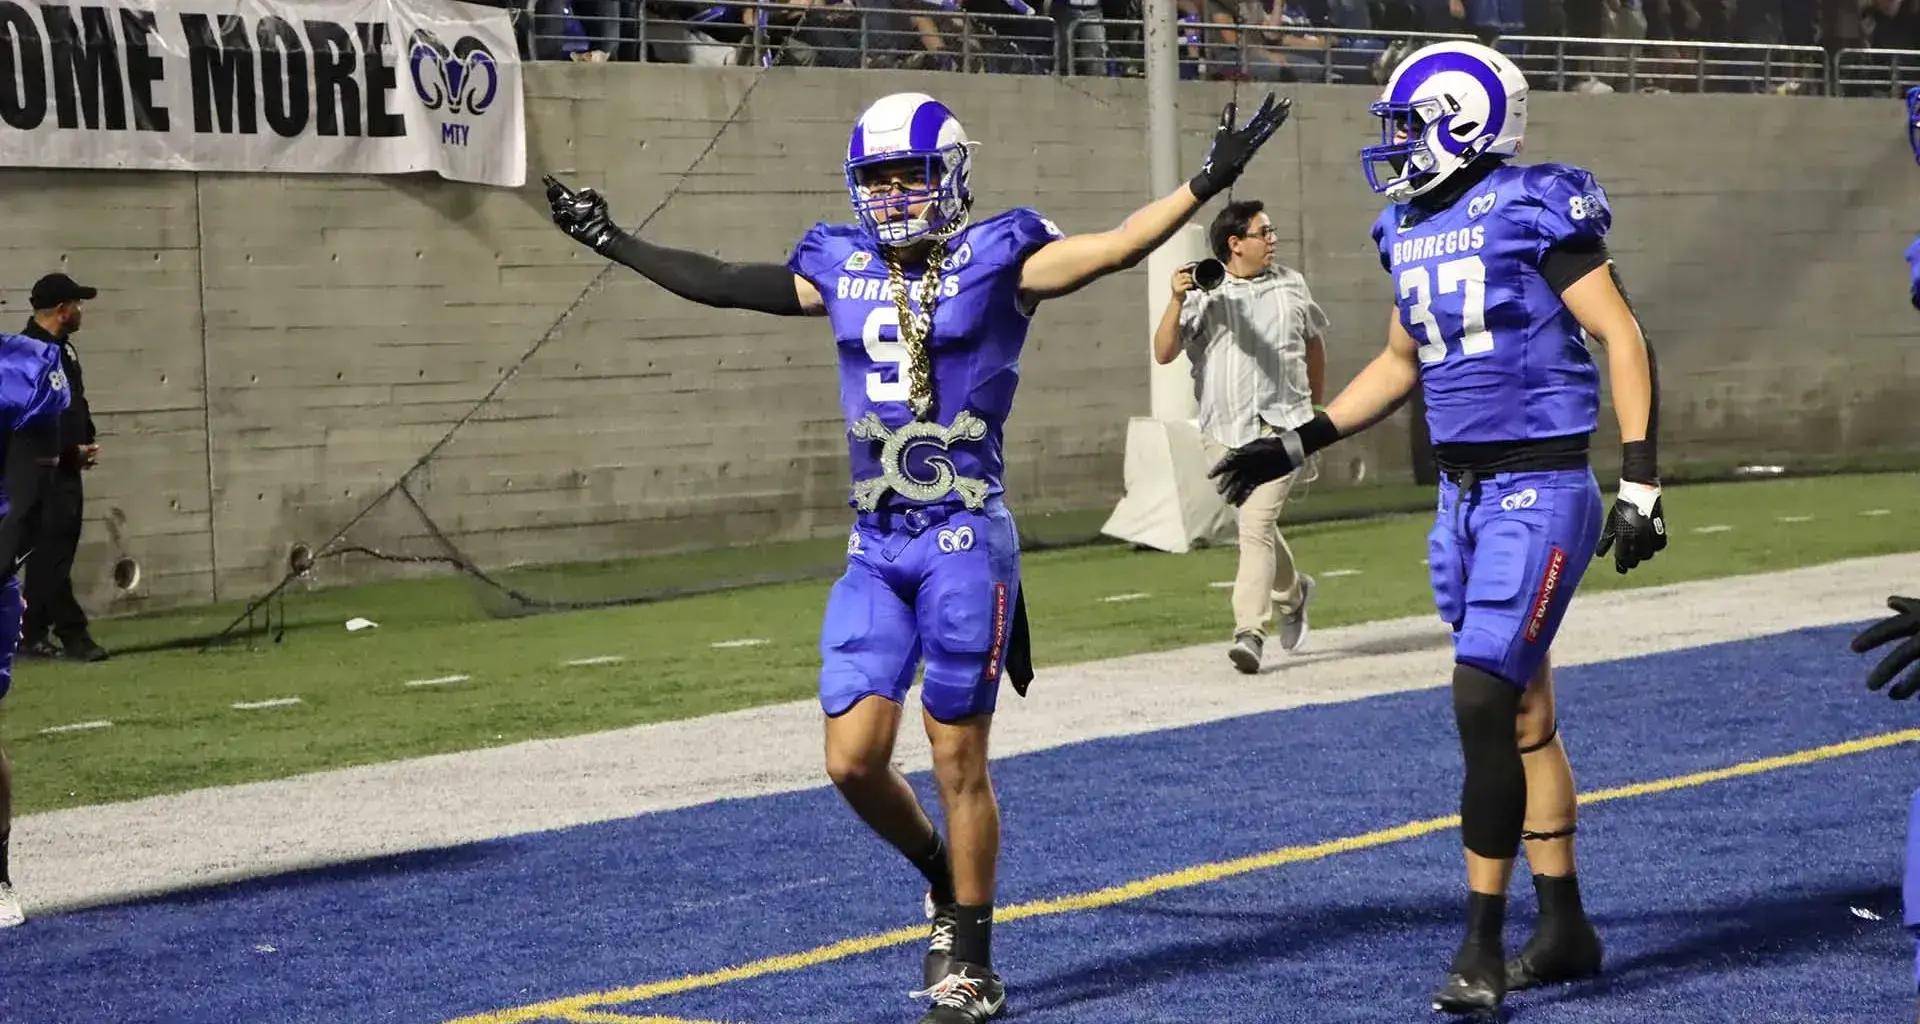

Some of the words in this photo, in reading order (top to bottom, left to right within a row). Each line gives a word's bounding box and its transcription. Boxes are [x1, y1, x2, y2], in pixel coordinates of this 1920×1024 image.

[180, 12, 407, 138] MORE
[441, 122, 470, 147] MTY
[1393, 225, 1485, 266] BORREGOS
[837, 275, 960, 301] BORRGS
[1399, 255, 1494, 363] 37
[1536, 551, 1563, 618] BANORTE
